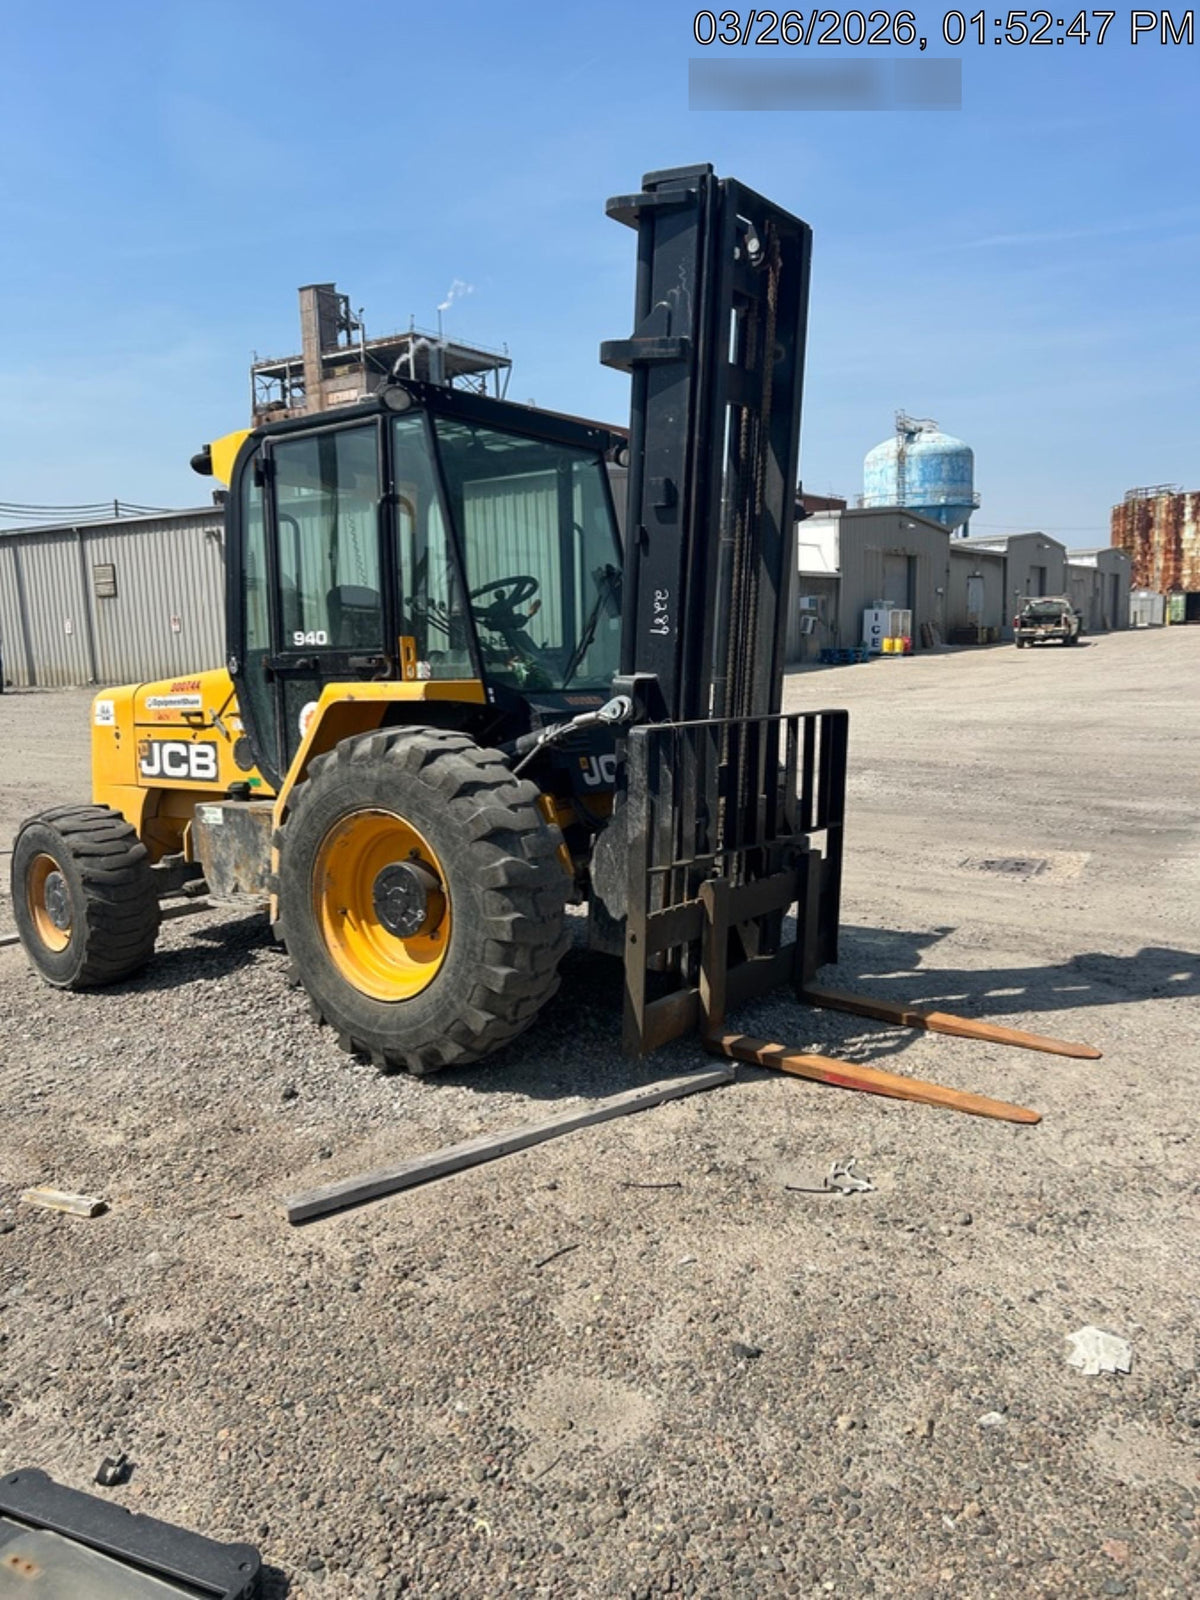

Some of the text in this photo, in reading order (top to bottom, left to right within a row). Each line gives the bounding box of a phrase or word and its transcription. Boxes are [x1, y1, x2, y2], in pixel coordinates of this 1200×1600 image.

[293, 630, 328, 646] 940
[871, 612, 881, 648] ICE
[141, 742, 217, 778] JCB
[583, 755, 615, 786] JC
